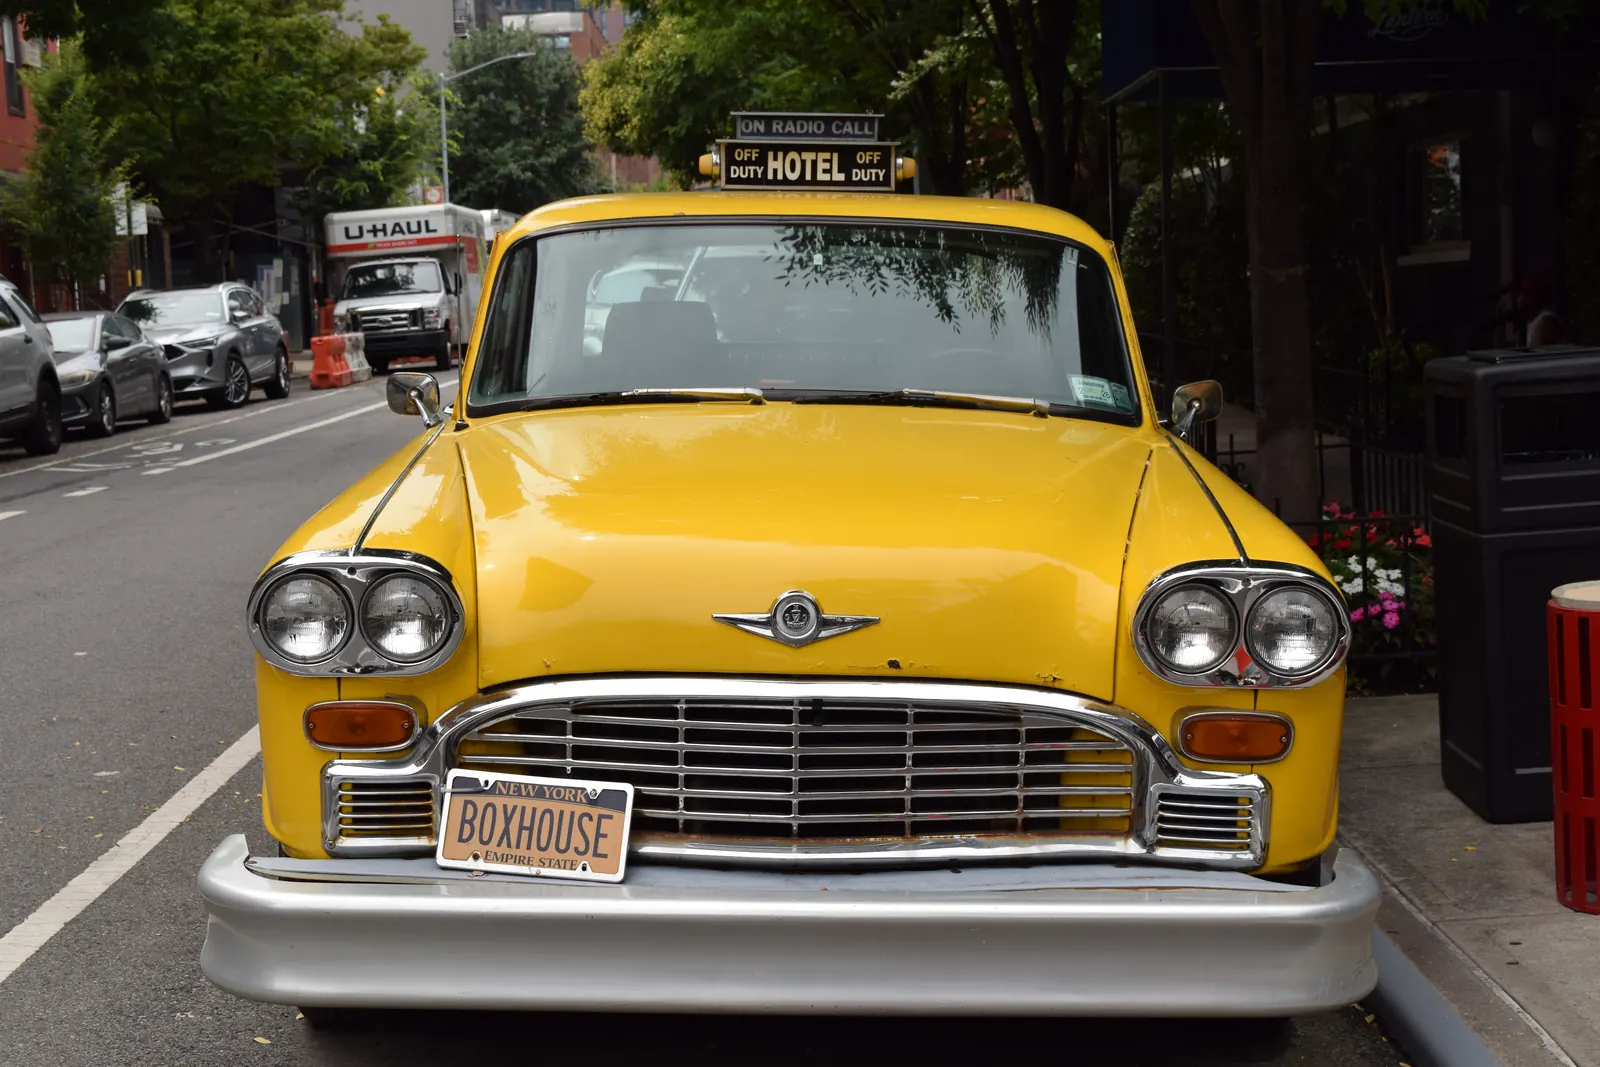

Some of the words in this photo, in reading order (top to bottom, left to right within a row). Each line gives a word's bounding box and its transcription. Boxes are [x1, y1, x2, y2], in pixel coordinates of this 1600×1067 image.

[741, 119, 765, 133] ON
[772, 120, 825, 134] RADIO
[831, 120, 873, 135] CALL
[734, 148, 760, 161] OFF
[856, 151, 881, 164] OFF
[730, 165, 764, 179] DUTY
[767, 151, 845, 181] HOTEL
[851, 168, 885, 182] DUTY
[344, 219, 437, 239] U-HAUL
[495, 781, 539, 797] NEW
[544, 786, 588, 803] YORK
[457, 799, 614, 859] BOXHOUSE
[484, 850, 535, 867] EMPIRE
[537, 856, 578, 871] STATE
